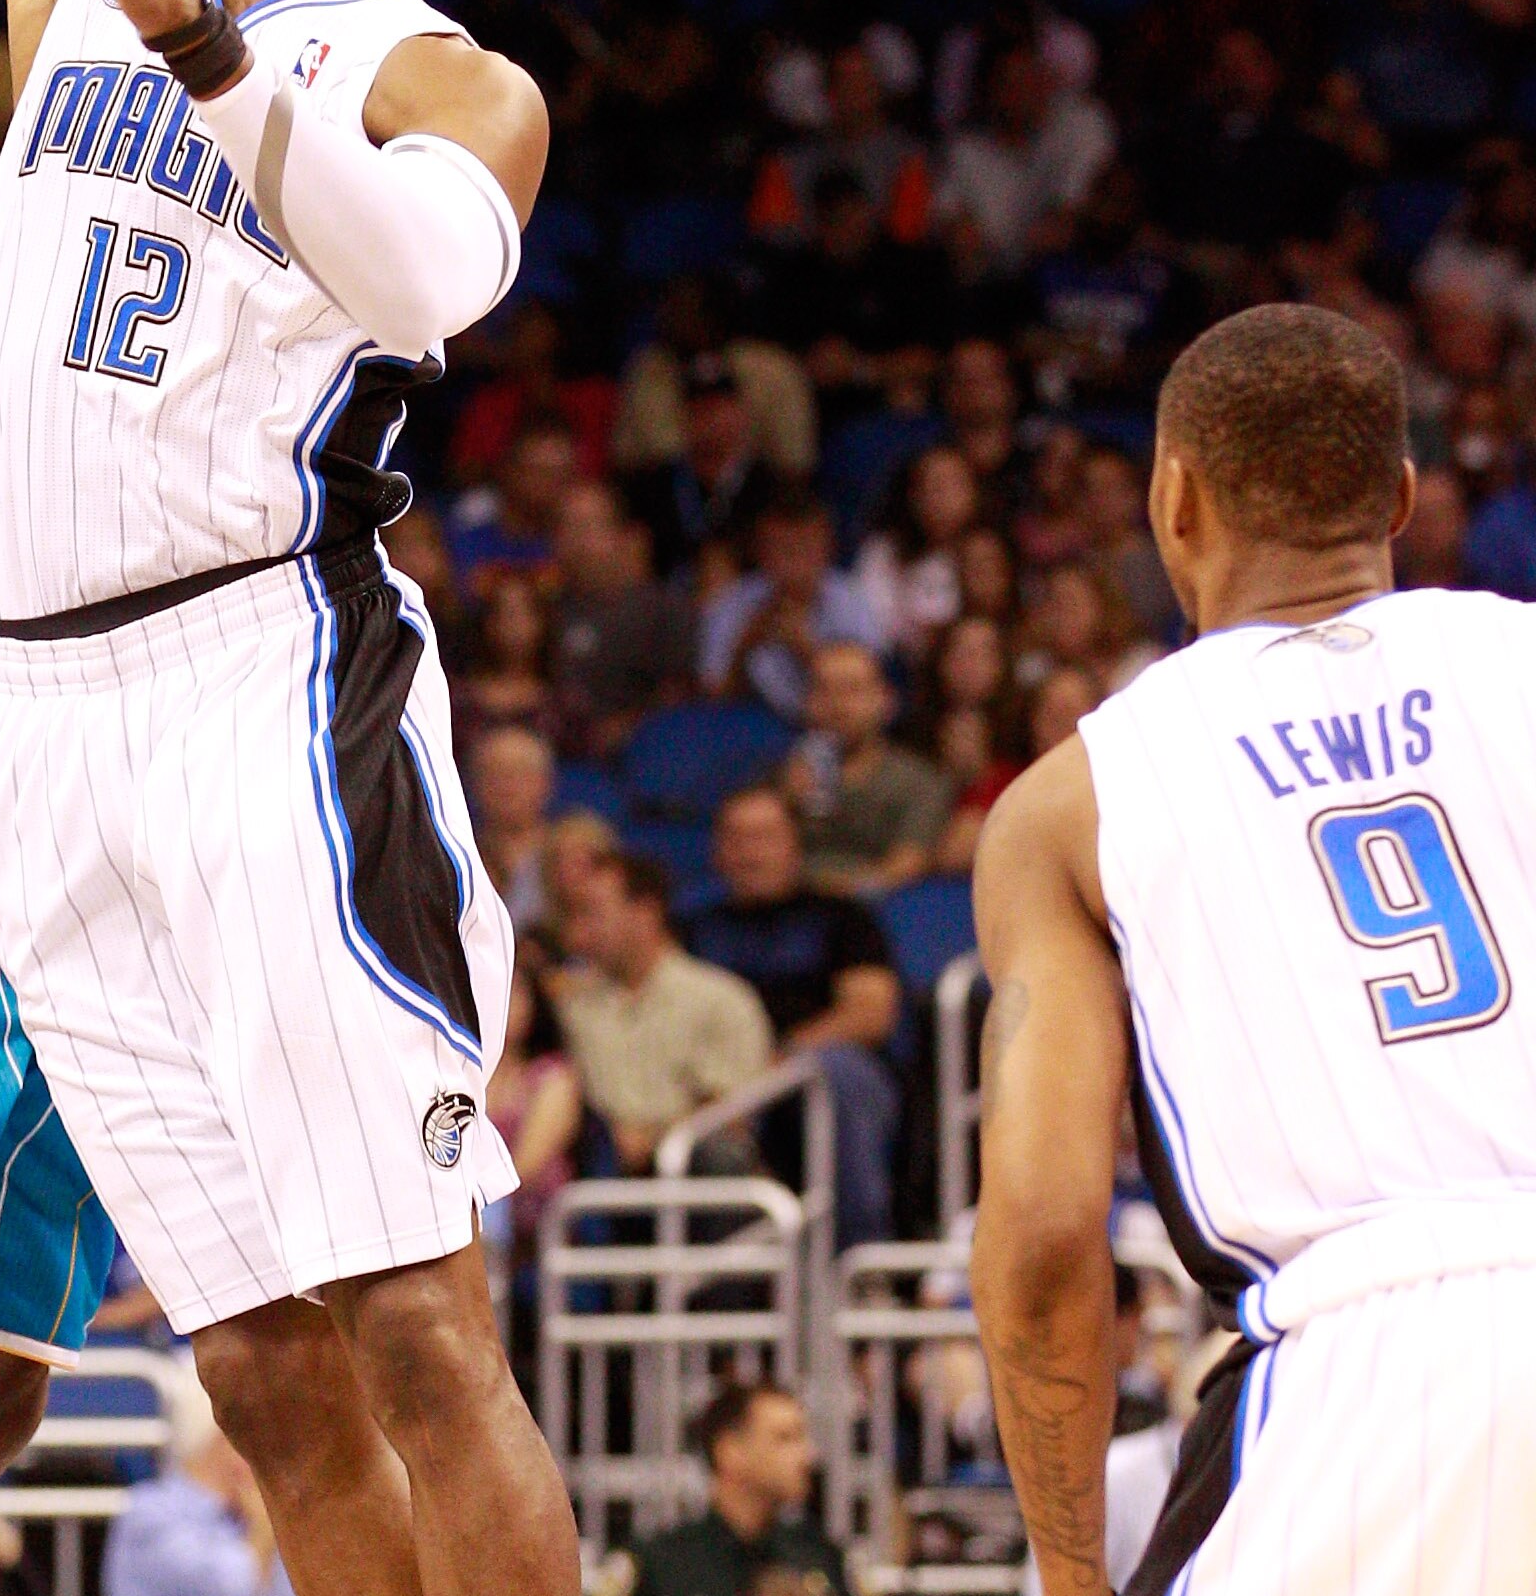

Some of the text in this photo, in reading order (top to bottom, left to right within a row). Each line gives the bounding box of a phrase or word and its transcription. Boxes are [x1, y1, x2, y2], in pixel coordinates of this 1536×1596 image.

[63, 217, 191, 387] 12
[1236, 689, 1433, 799] LEWIS
[1307, 792, 1512, 1047] 9
